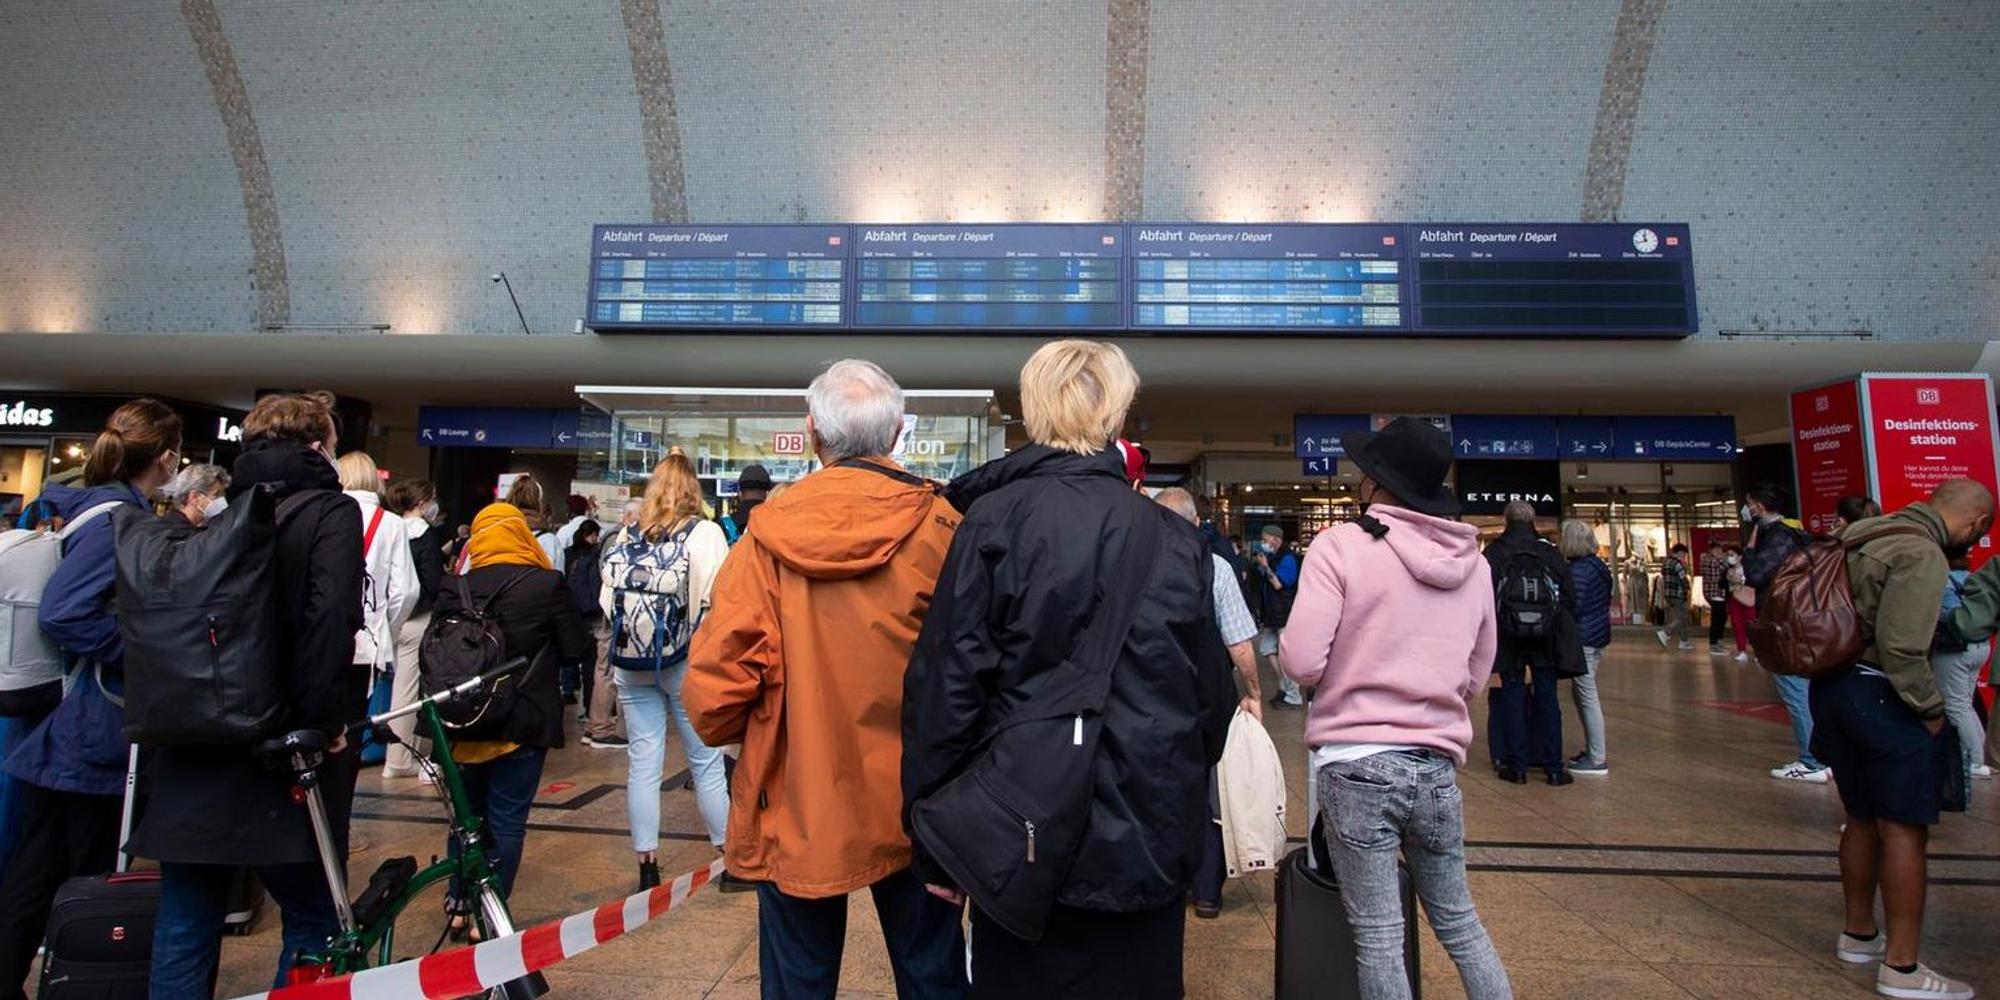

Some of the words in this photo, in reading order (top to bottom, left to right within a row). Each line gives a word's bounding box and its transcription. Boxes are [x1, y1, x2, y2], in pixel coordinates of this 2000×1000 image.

[603, 231, 643, 242] Abfahrt
[648, 232, 691, 243] Departure
[864, 230, 907, 241] Abfahrt
[912, 232, 956, 243] Departure
[1139, 230, 1183, 241] Abfahrt
[1189, 231, 1233, 242] Departure
[1420, 230, 1464, 241] Abfahrt
[1470, 232, 1517, 243] Departure
[1920, 390, 1936, 401] DB
[218, 416, 243, 442] Le
[1799, 422, 1854, 440] Desinfektions-
[1884, 419, 1979, 431] Desinfektions-
[777, 436, 802, 451] DB
[1813, 438, 1841, 452] station
[1910, 434, 1957, 445] station
[1322, 457, 1330, 470] 1
[1467, 493, 1554, 502] ETERNA
